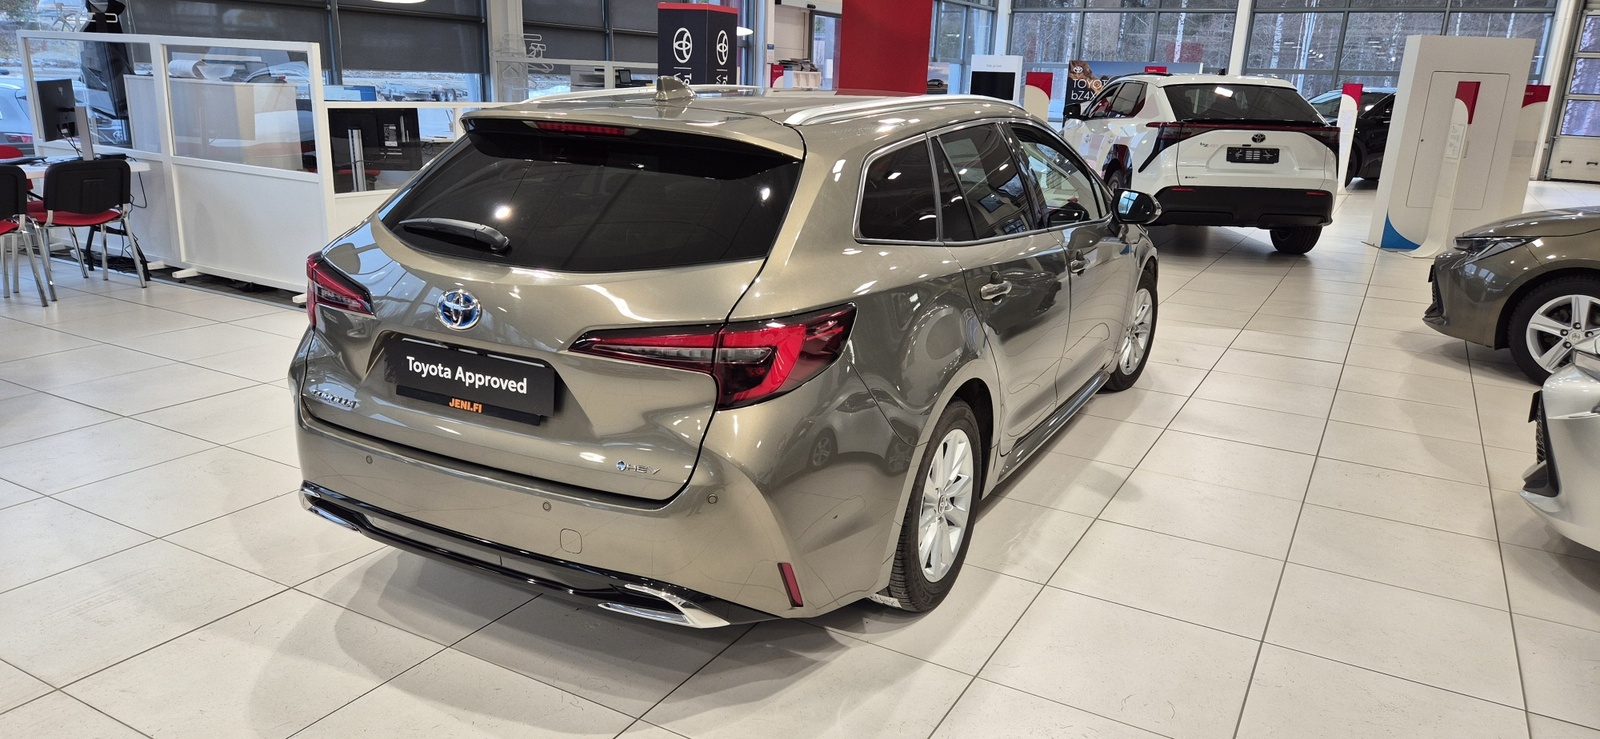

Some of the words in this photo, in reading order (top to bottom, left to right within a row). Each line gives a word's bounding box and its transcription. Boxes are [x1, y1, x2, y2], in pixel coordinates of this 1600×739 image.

[1072, 78, 1108, 90] TOYOT
[406, 355, 452, 379] Toyota
[454, 366, 528, 395] Approved
[449, 397, 483, 413] JENI.FI
